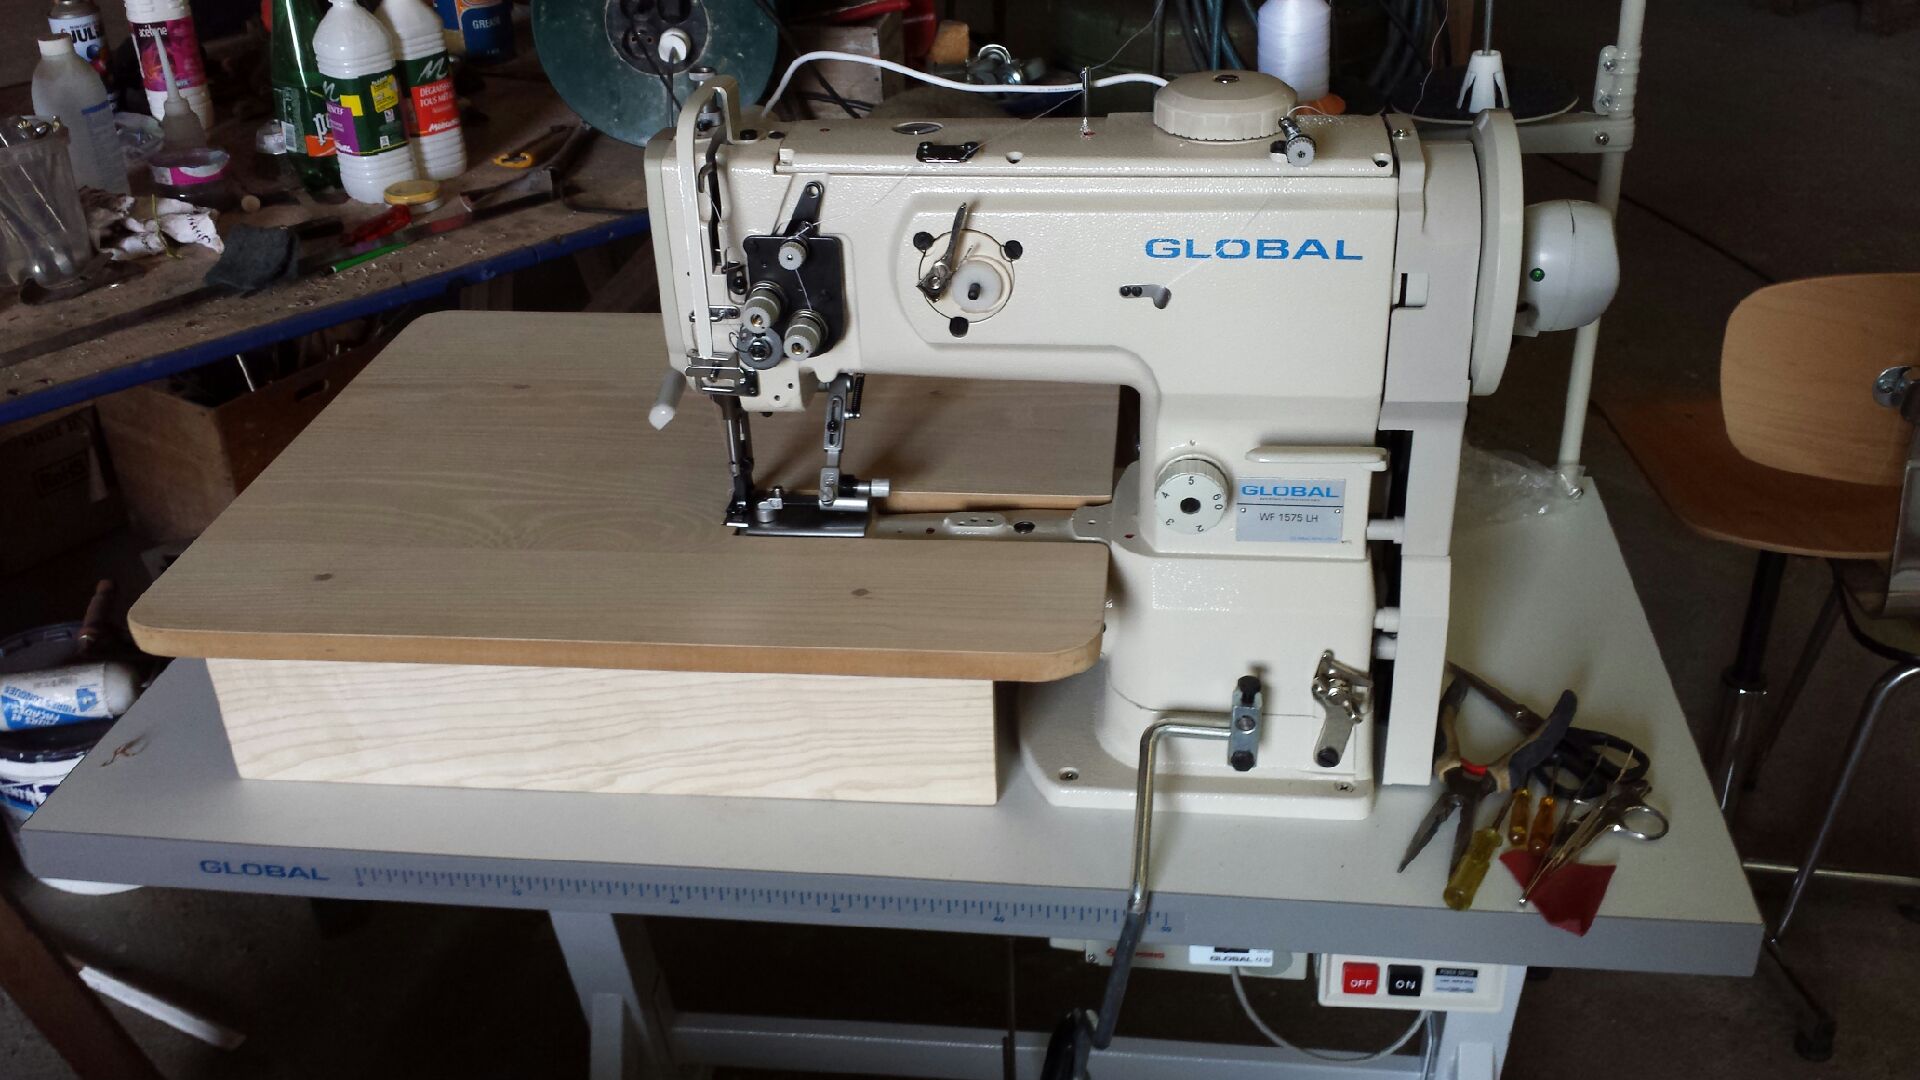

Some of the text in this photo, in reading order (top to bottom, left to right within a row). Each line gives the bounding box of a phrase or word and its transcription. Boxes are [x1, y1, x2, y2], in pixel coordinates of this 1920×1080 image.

[1145, 238, 1364, 260] GLOBAL
[1188, 476, 1195, 485] 5
[1241, 485, 1340, 498] GLOBAL
[1259, 512, 1318, 523] WF 1575 LH
[199, 859, 331, 881] GLOBAL
[1350, 979, 1416, 990] OFF ON
